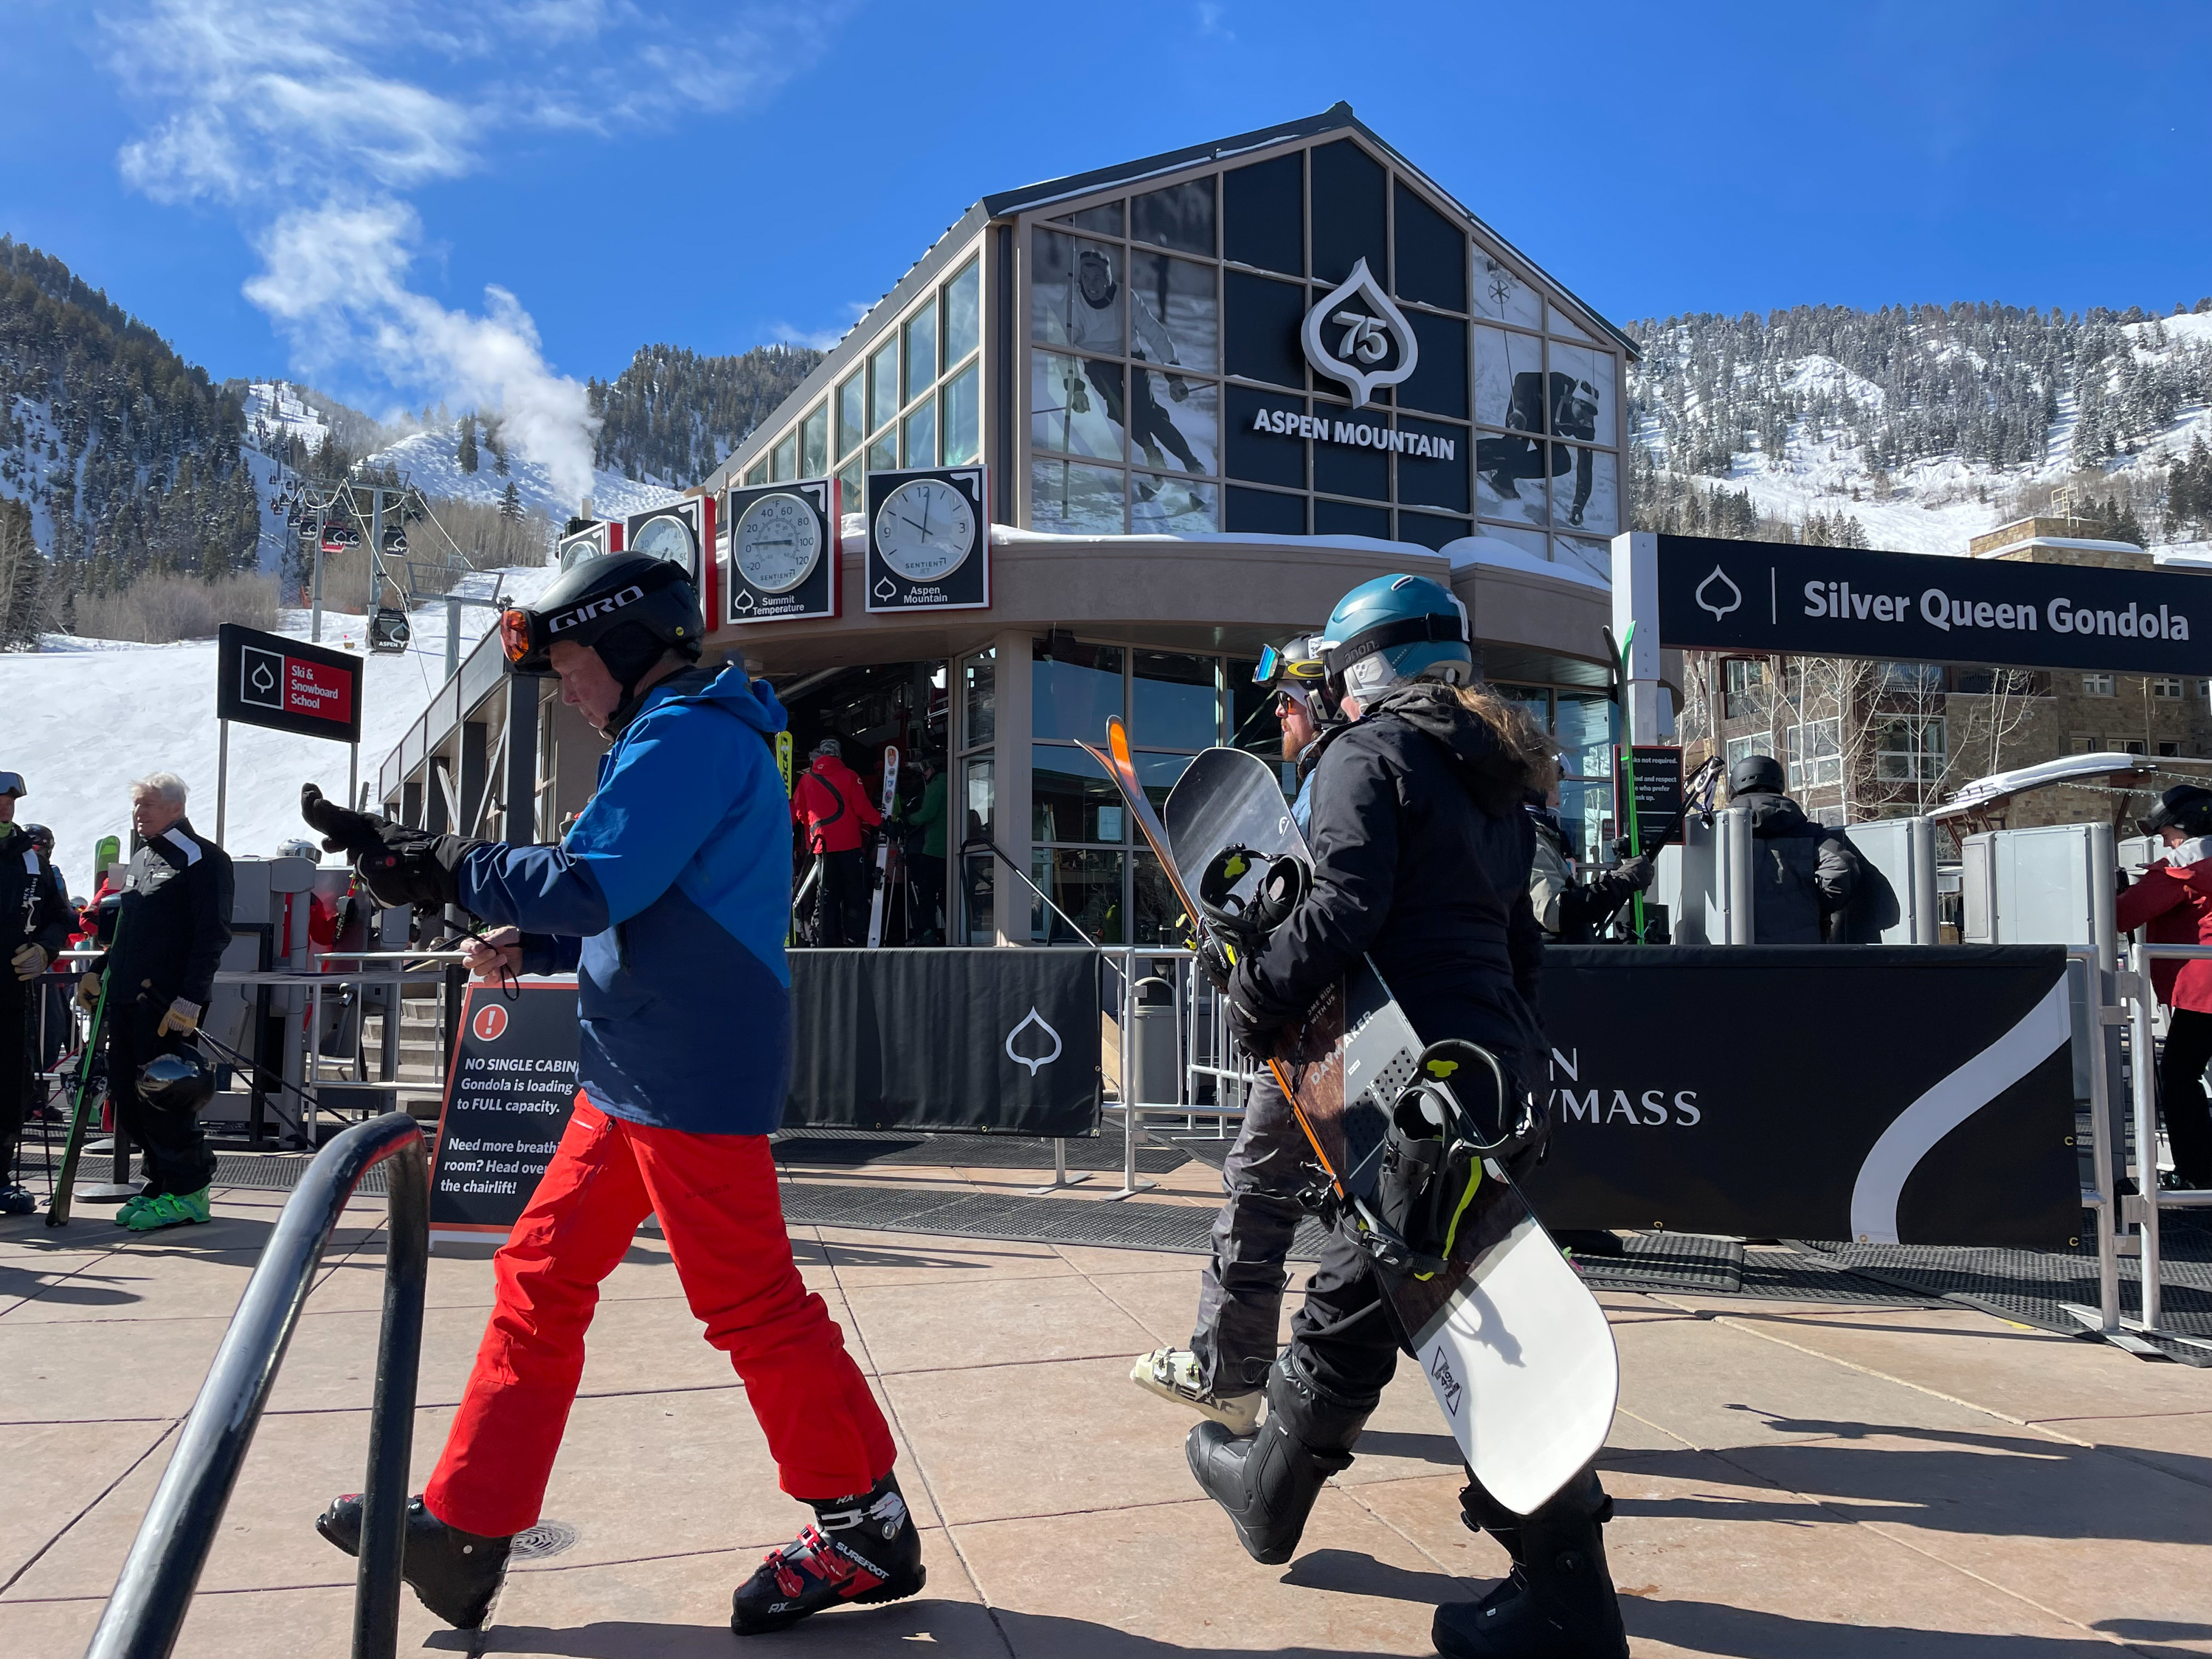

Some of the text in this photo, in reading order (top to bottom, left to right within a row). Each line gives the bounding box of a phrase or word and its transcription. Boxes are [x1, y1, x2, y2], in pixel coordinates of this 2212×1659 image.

[1332, 311, 1388, 364] 75
[1253, 408, 1455, 461] ASPEN MOUNTAIN
[916, 486, 930, 498] 12
[761, 508, 773, 517] 40
[781, 506, 792, 515] 60
[798, 517, 809, 526] 80
[657, 525, 666, 534] 30
[747, 524, 758, 533] 20
[884, 527, 891, 538] 9
[958, 522, 966, 534] 3
[674, 531, 683, 539] 40
[640, 539, 649, 549] 20
[800, 537, 815, 546] 100
[746, 545, 752, 553] 0
[747, 562, 761, 570] -20
[795, 556, 809, 565] 120
[905, 561, 944, 569] SENTIENT
[760, 571, 792, 582] SENTIENT
[910, 586, 941, 596] Aspen
[761, 595, 795, 606] Summit
[903, 594, 948, 604] Mountain
[548, 585, 644, 633] GIRO
[753, 604, 805, 615] Temperature
[1804, 580, 2189, 641] Silver Queen Gondola
[291, 665, 314, 680] Ski &
[291, 679, 339, 700] Snowboard
[291, 693, 320, 709] School
[1652, 784, 1670, 793] prefer
[1310, 1005, 1327, 1025] WITH
[1326, 994, 1335, 1007] US
[1310, 1010, 1374, 1086] DAYMAKER
[464, 1058, 579, 1073] NO SINGLE CABIN
[460, 1077, 574, 1095] Gondola is loading
[457, 1098, 560, 1115] to FULL capacity.
[1549, 1089, 1701, 1126] MASS
[448, 1137, 481, 1151] Need
[482, 1142, 514, 1153] more
[444, 1159, 484, 1172] room?
[485, 1159, 519, 1173] Head
[440, 1179, 517, 1195] the chairlift!
[1441, 1371, 1452, 1387] 49
[835, 1541, 890, 1579] SUREFOOT
[768, 1602, 789, 1613] RX
